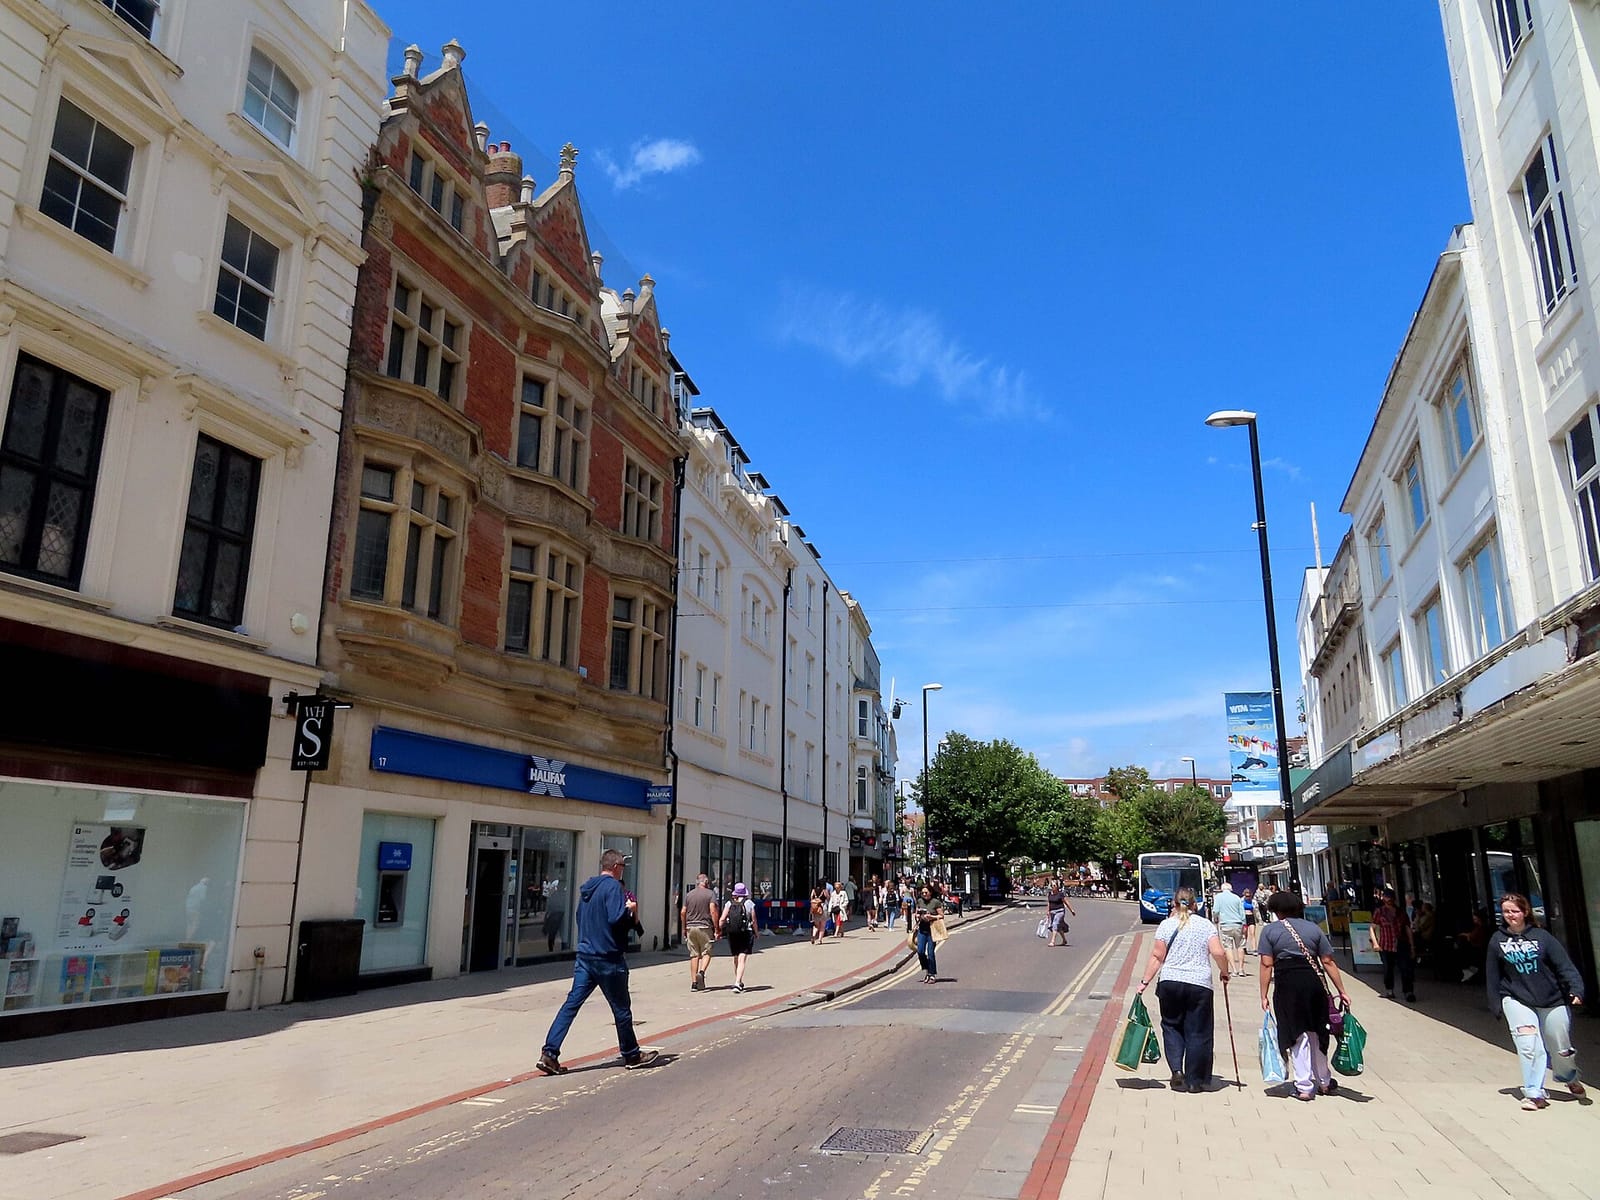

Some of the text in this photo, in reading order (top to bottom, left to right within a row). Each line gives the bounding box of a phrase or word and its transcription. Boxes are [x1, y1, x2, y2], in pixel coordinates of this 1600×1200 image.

[305, 706, 325, 718] WH
[298, 717, 322, 758] S
[379, 757, 387, 767] 17
[530, 768, 566, 786] HALIFAX
[1514, 960, 1537, 974] UP!
